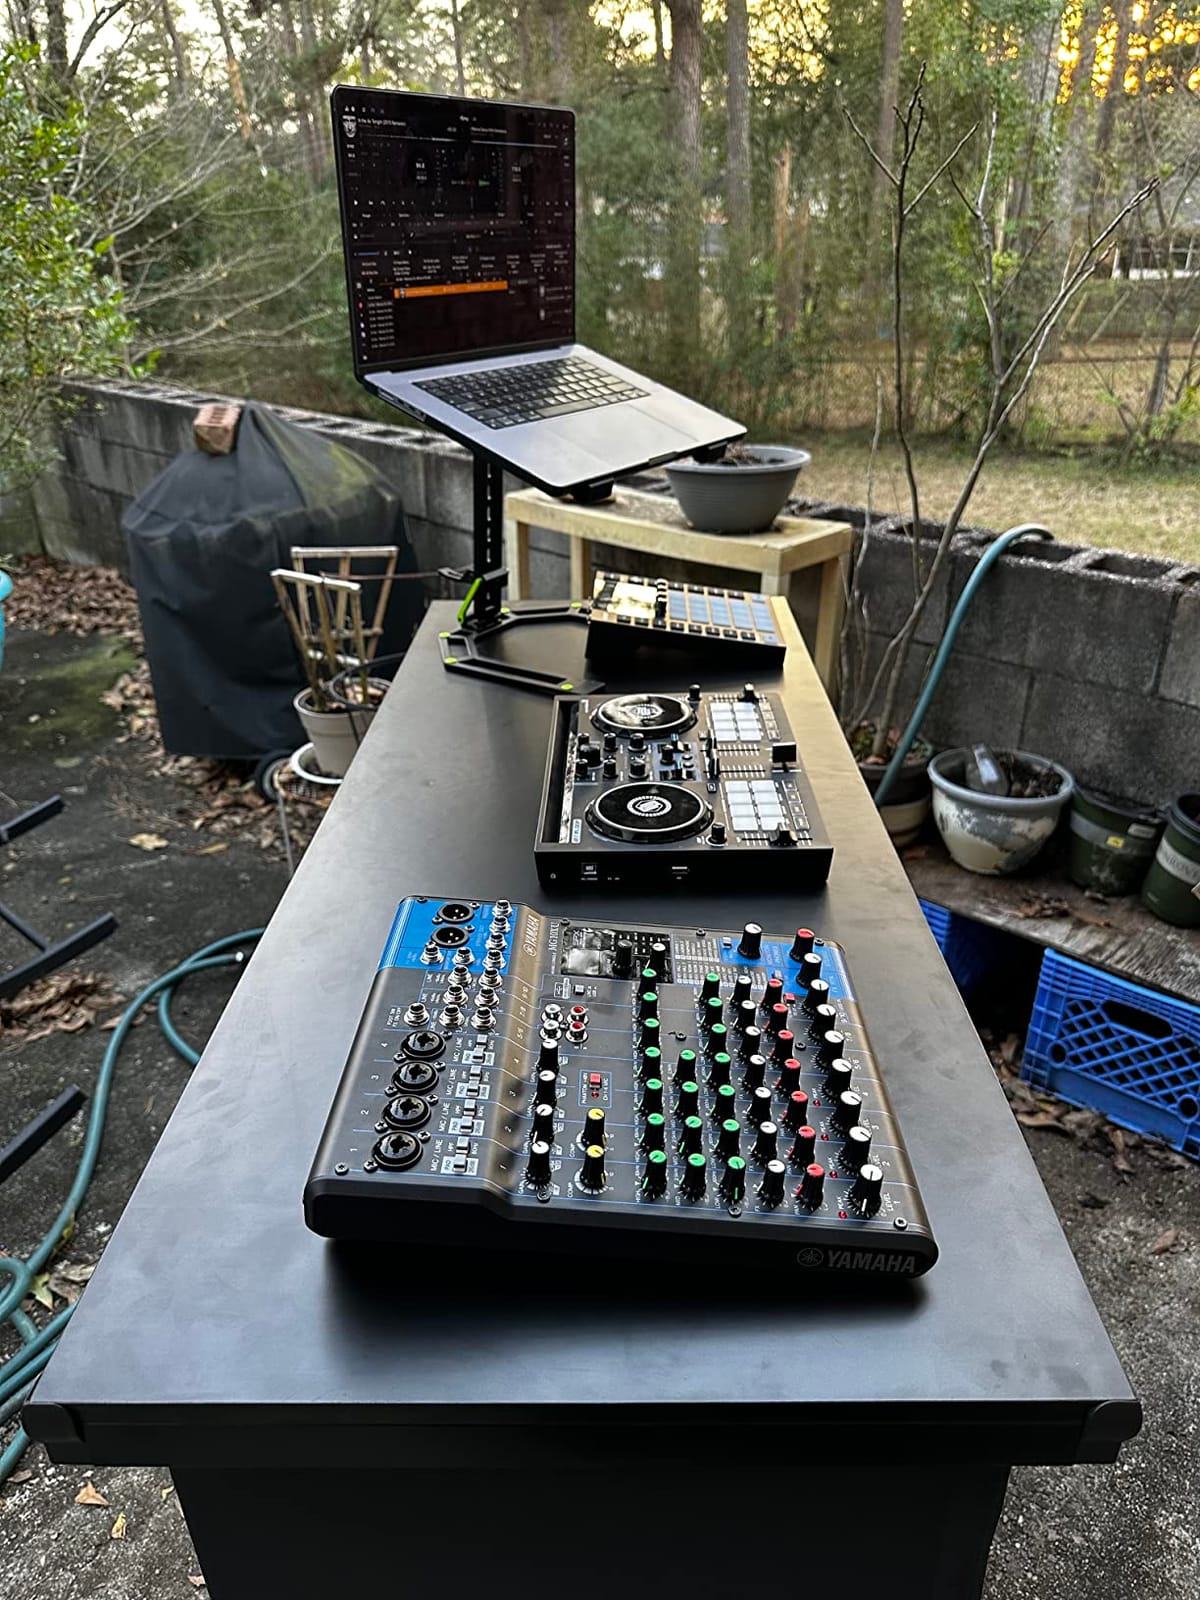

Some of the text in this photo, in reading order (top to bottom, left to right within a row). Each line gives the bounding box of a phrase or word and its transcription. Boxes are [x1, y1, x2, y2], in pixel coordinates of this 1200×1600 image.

[528, 914, 540, 947] YAMAHA
[449, 1068, 457, 1080] LINE
[446, 1083, 454, 1095] MIC
[441, 1102, 450, 1116] LINE
[438, 1119, 447, 1132] MIC
[434, 1139, 444, 1154] LINE
[430, 1157, 440, 1171] MIC
[518, 1180, 526, 1194] GAIN
[883, 1192, 894, 1211] LEVEL
[827, 1250, 916, 1273] YAMAHA
